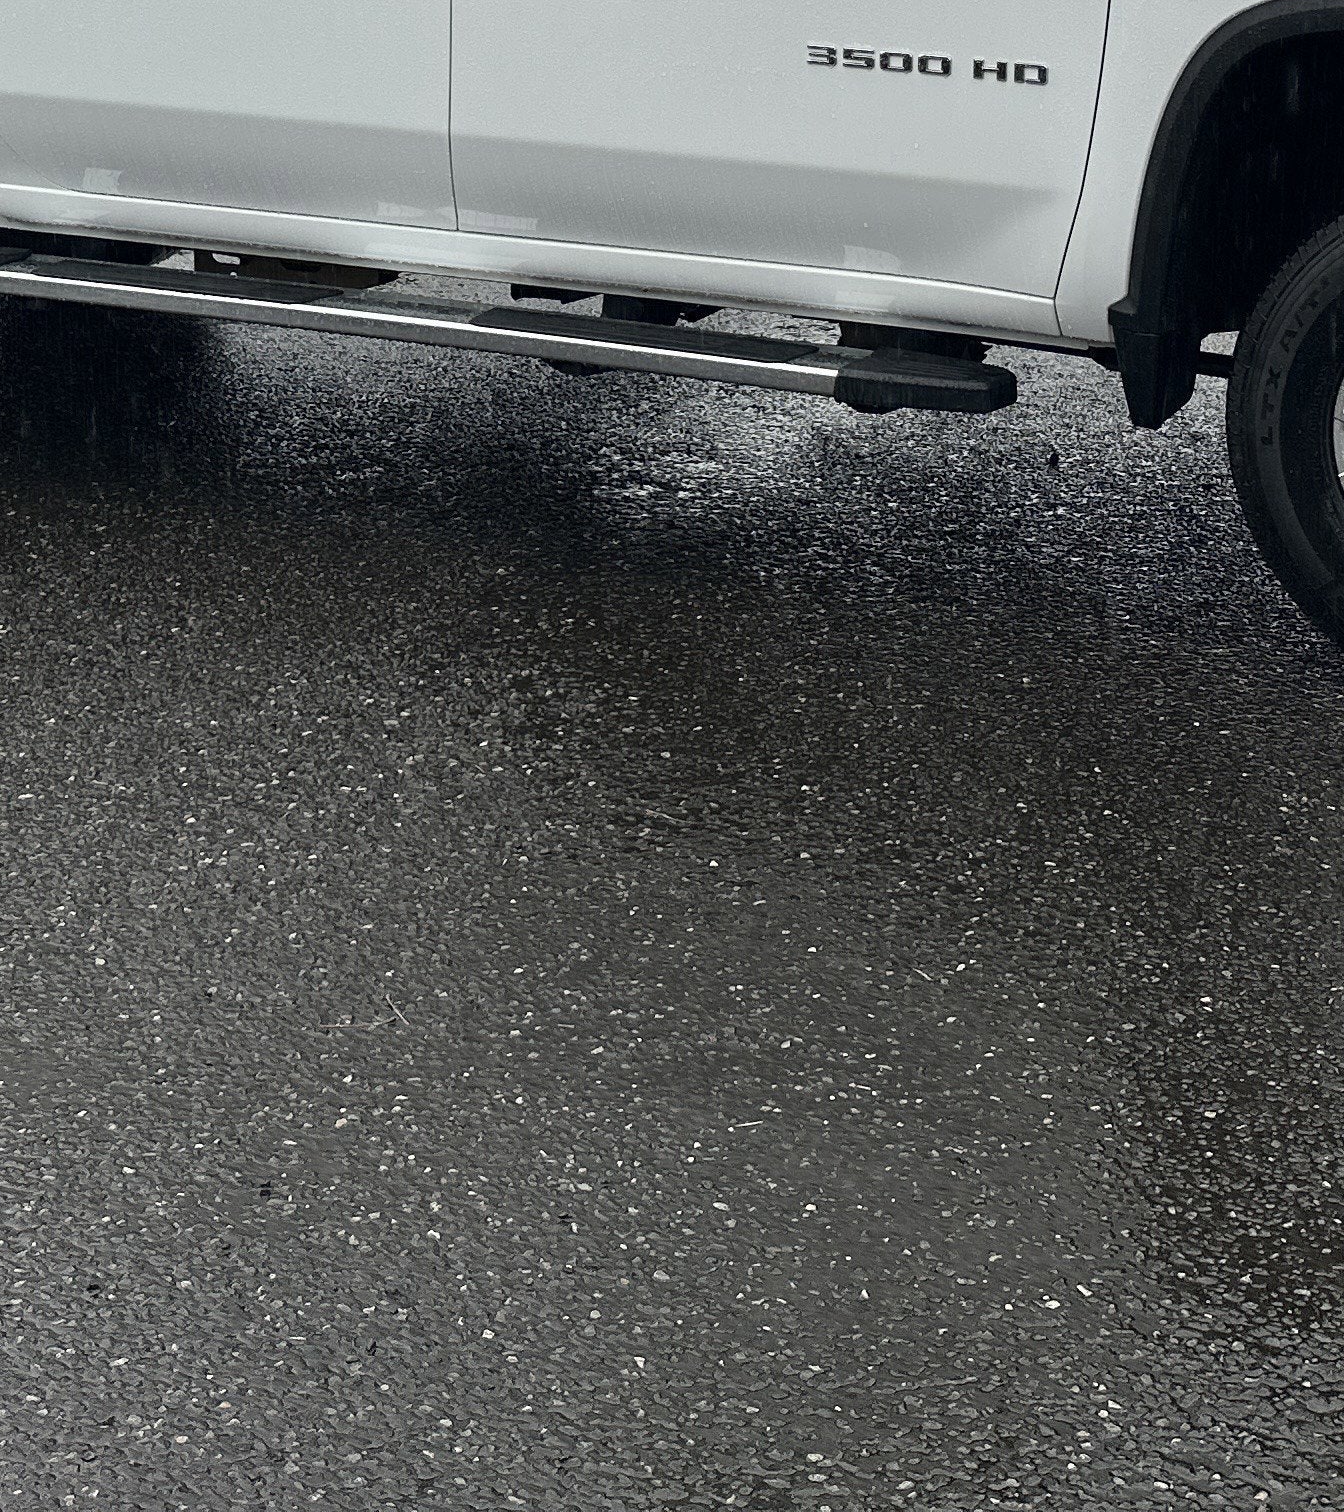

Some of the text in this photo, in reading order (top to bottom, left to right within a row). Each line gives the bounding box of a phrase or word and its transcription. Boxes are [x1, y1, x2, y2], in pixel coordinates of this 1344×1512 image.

[806, 44, 1048, 85] 3500 HD
[1260, 365, 1284, 446] LTX
